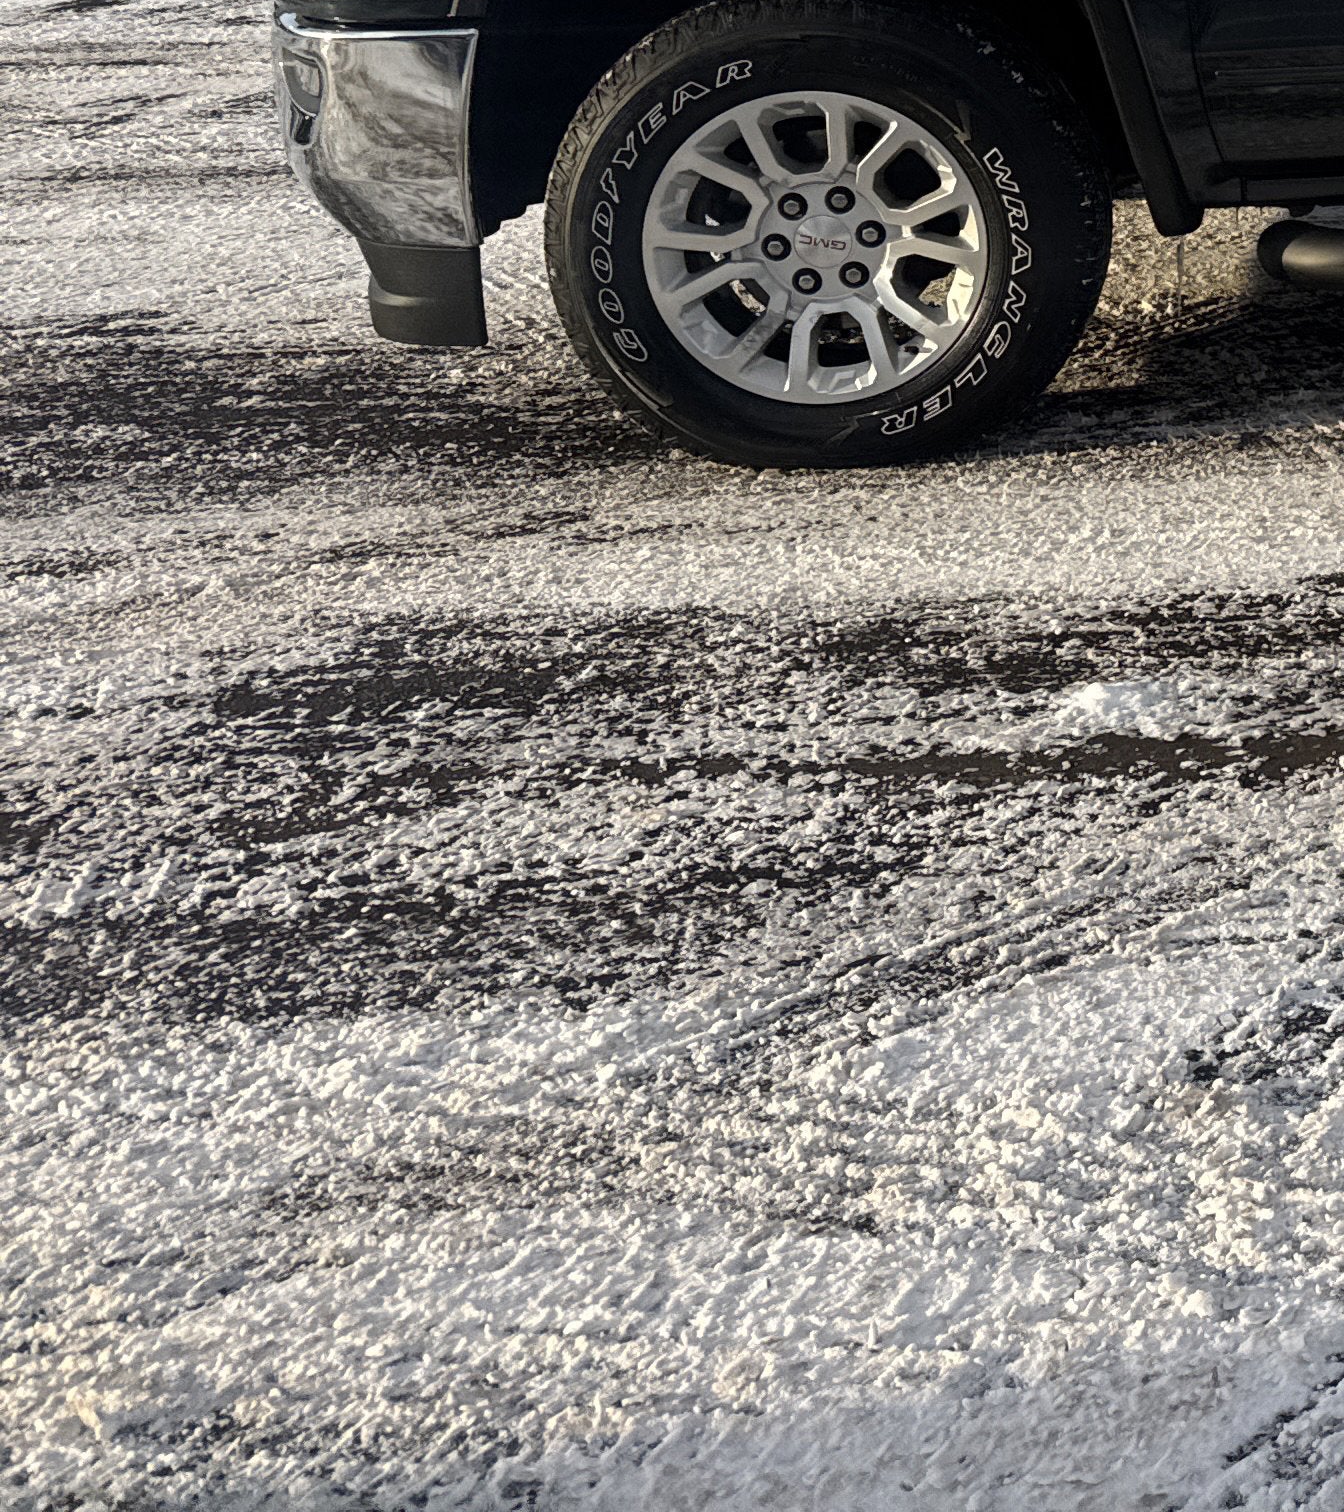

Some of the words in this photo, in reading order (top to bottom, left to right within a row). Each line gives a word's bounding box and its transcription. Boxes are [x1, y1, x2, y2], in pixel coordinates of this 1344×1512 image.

[591, 60, 752, 363] GOODYEAR
[799, 234, 847, 251] GMC
[881, 147, 1032, 435] WRANGLER
